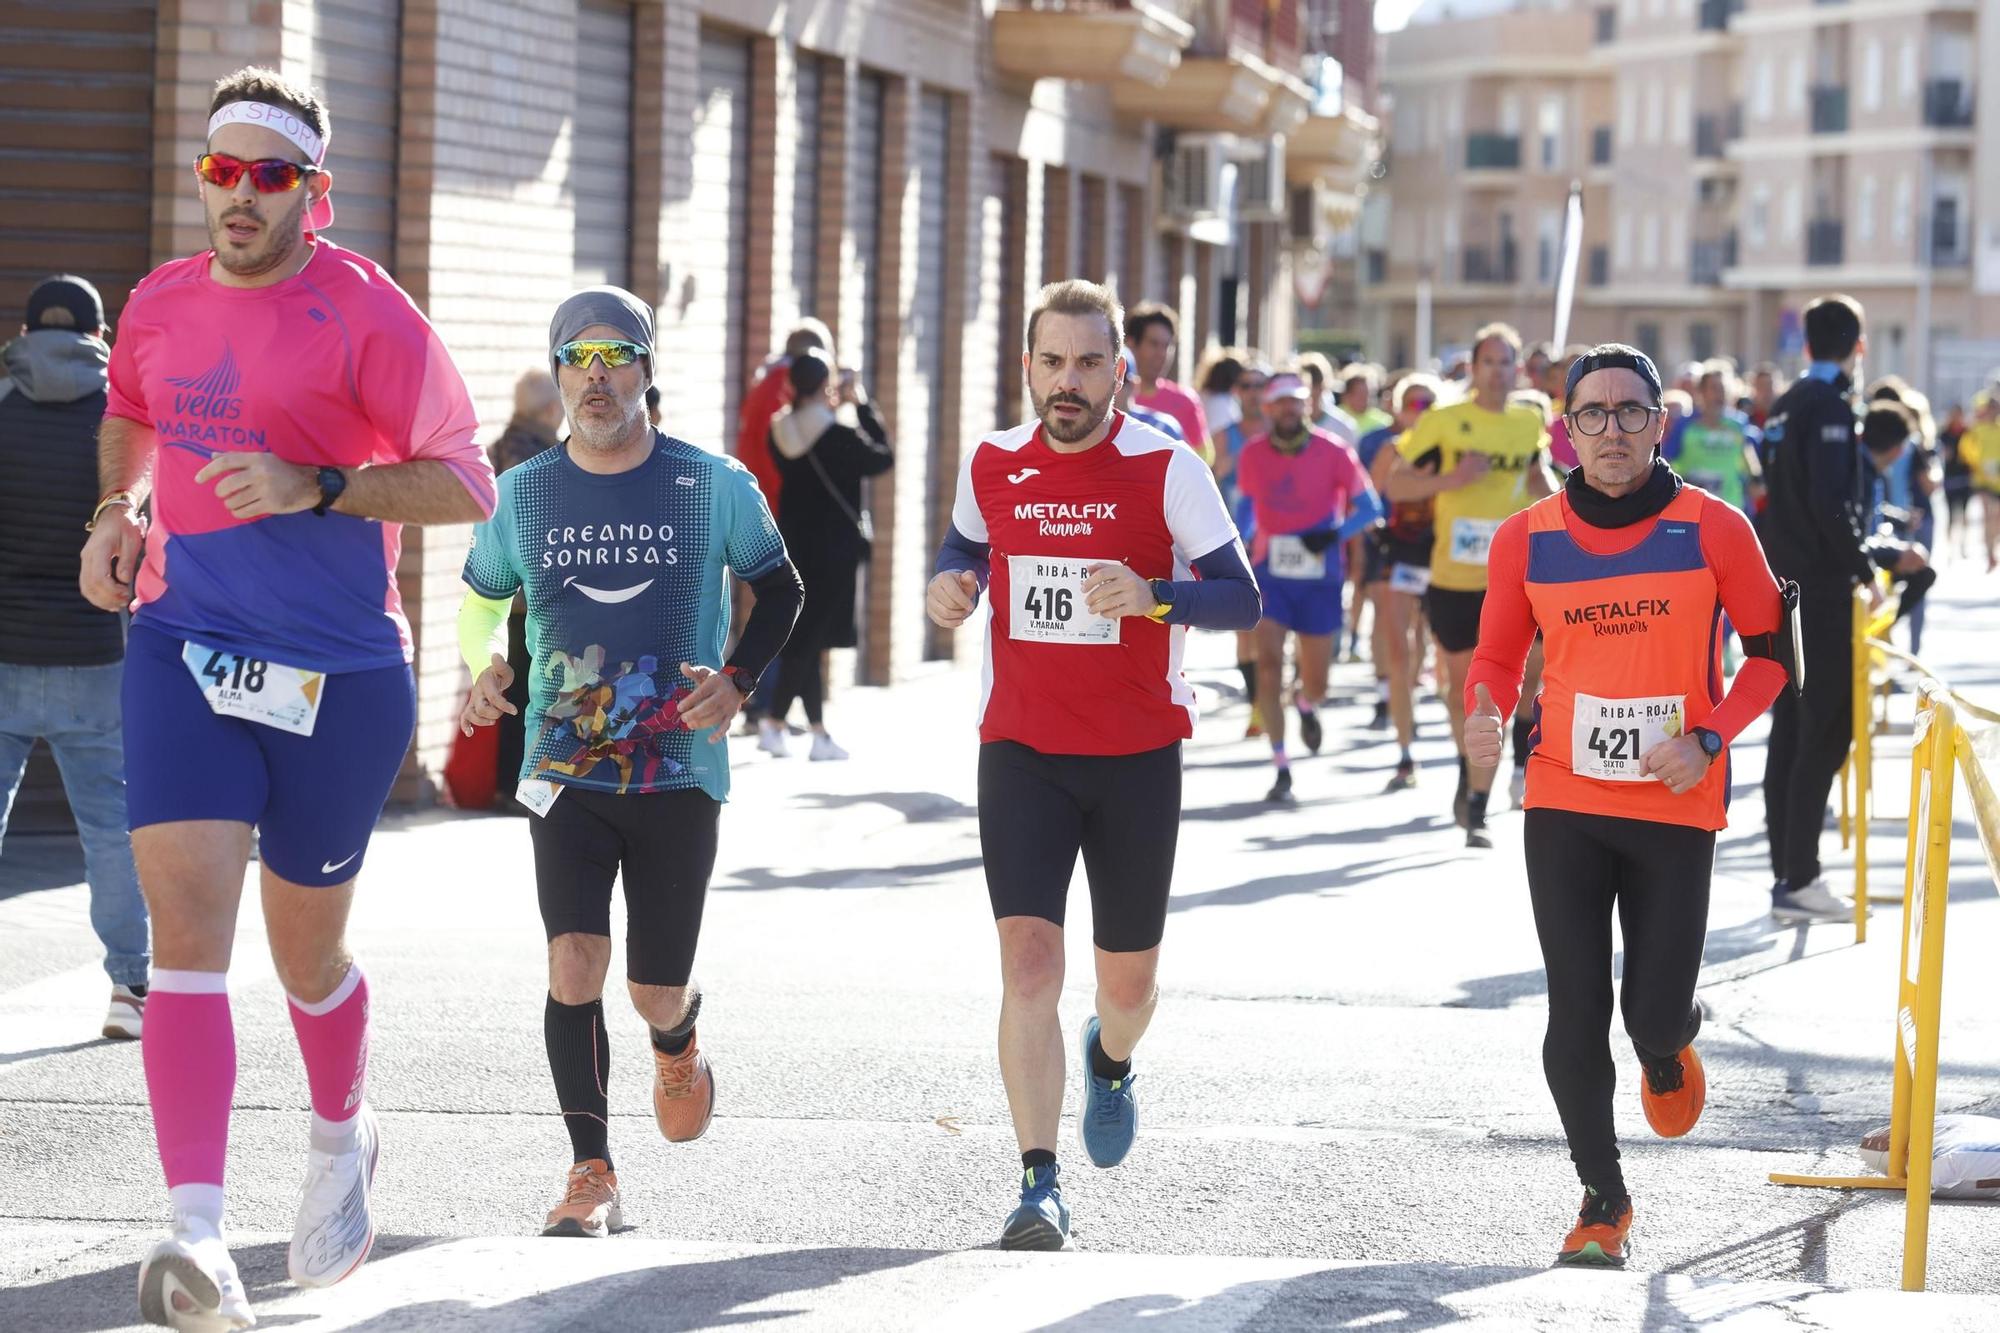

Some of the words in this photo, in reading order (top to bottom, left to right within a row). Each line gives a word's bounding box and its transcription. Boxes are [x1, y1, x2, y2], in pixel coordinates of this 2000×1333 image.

[156, 419, 266, 447] MARATON
[1014, 503, 1118, 520] METALFIX
[547, 523, 674, 545] CREANDO
[1039, 519, 1094, 537] Runners
[542, 546, 678, 569] SONRISAS
[1037, 564, 1092, 579] RIBA-R
[1024, 586, 1073, 621] 416
[1563, 599, 1670, 625] METALFIX
[1593, 620, 1648, 637] Runners
[202, 651, 268, 693] 418
[217, 689, 243, 701] ALMA
[1588, 727, 1640, 760] 421
[1603, 760, 1625, 769] SIXTO
